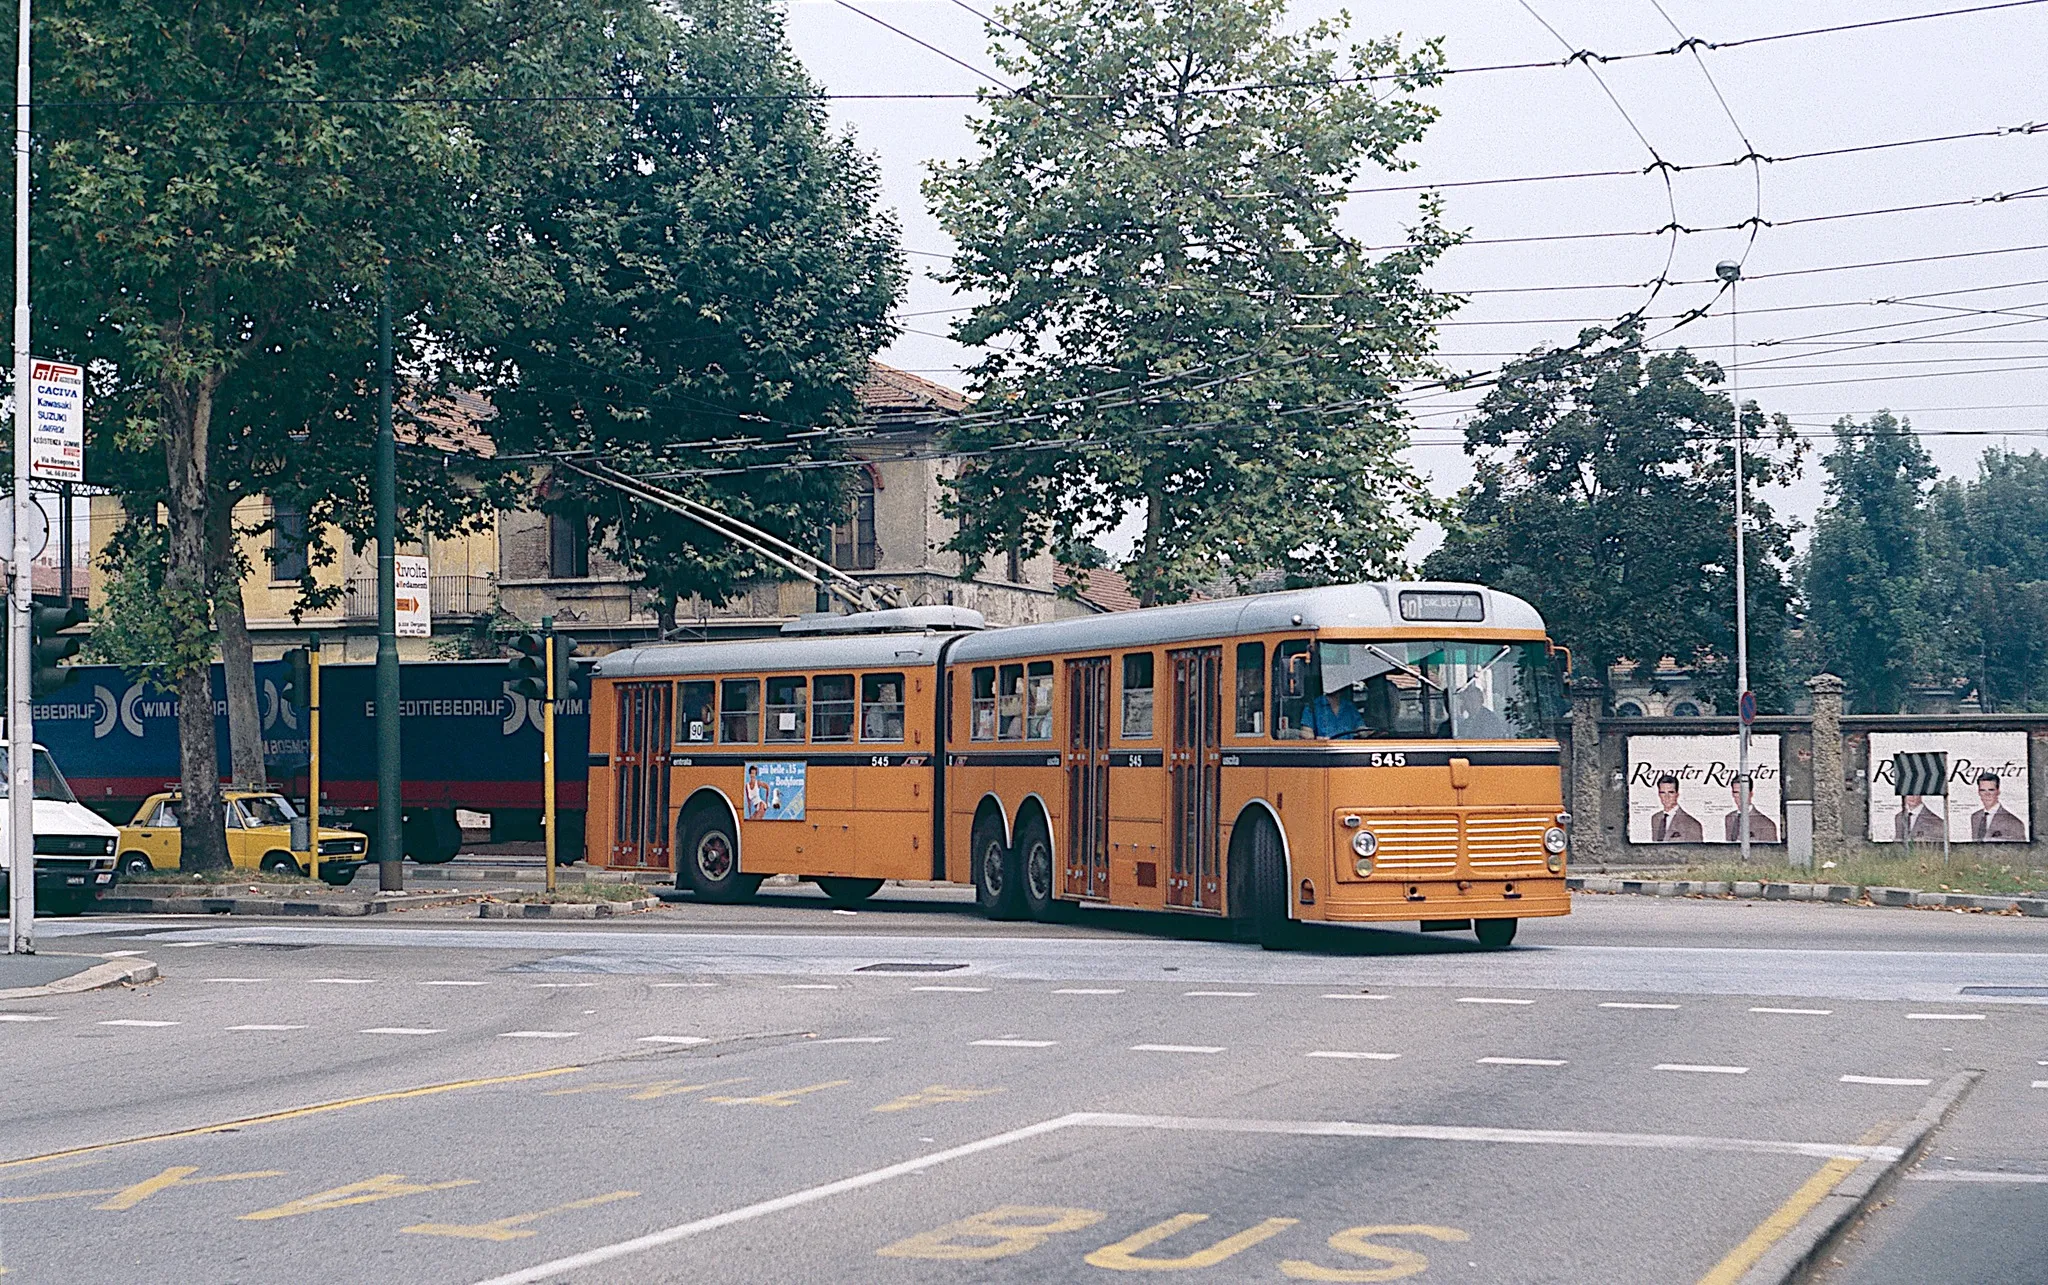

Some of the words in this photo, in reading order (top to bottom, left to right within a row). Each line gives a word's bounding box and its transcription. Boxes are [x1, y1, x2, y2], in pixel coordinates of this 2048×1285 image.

[37, 397, 72, 410] Kawasaki
[37, 410, 67, 422] SUZUKI
[395, 561, 427, 579] Rivolta
[33, 704, 96, 720] EBEDRIJF
[142, 702, 171, 717] WIM
[365, 700, 504, 717] EEDITIEBEDRIJF
[553, 699, 583, 715] WIM
[691, 724, 703, 736] 90
[270, 739, 310, 755] BOSMA
[871, 756, 889, 767] 545
[1128, 754, 1142, 767] 545
[1222, 754, 1240, 766] uscita
[1371, 752, 1406, 767] 545
[1630, 761, 1704, 788] Reporter
[1703, 761, 1778, 788] Reprter
[1948, 758, 2026, 786] Reporter
[876, 1205, 1471, 1283] BUS
